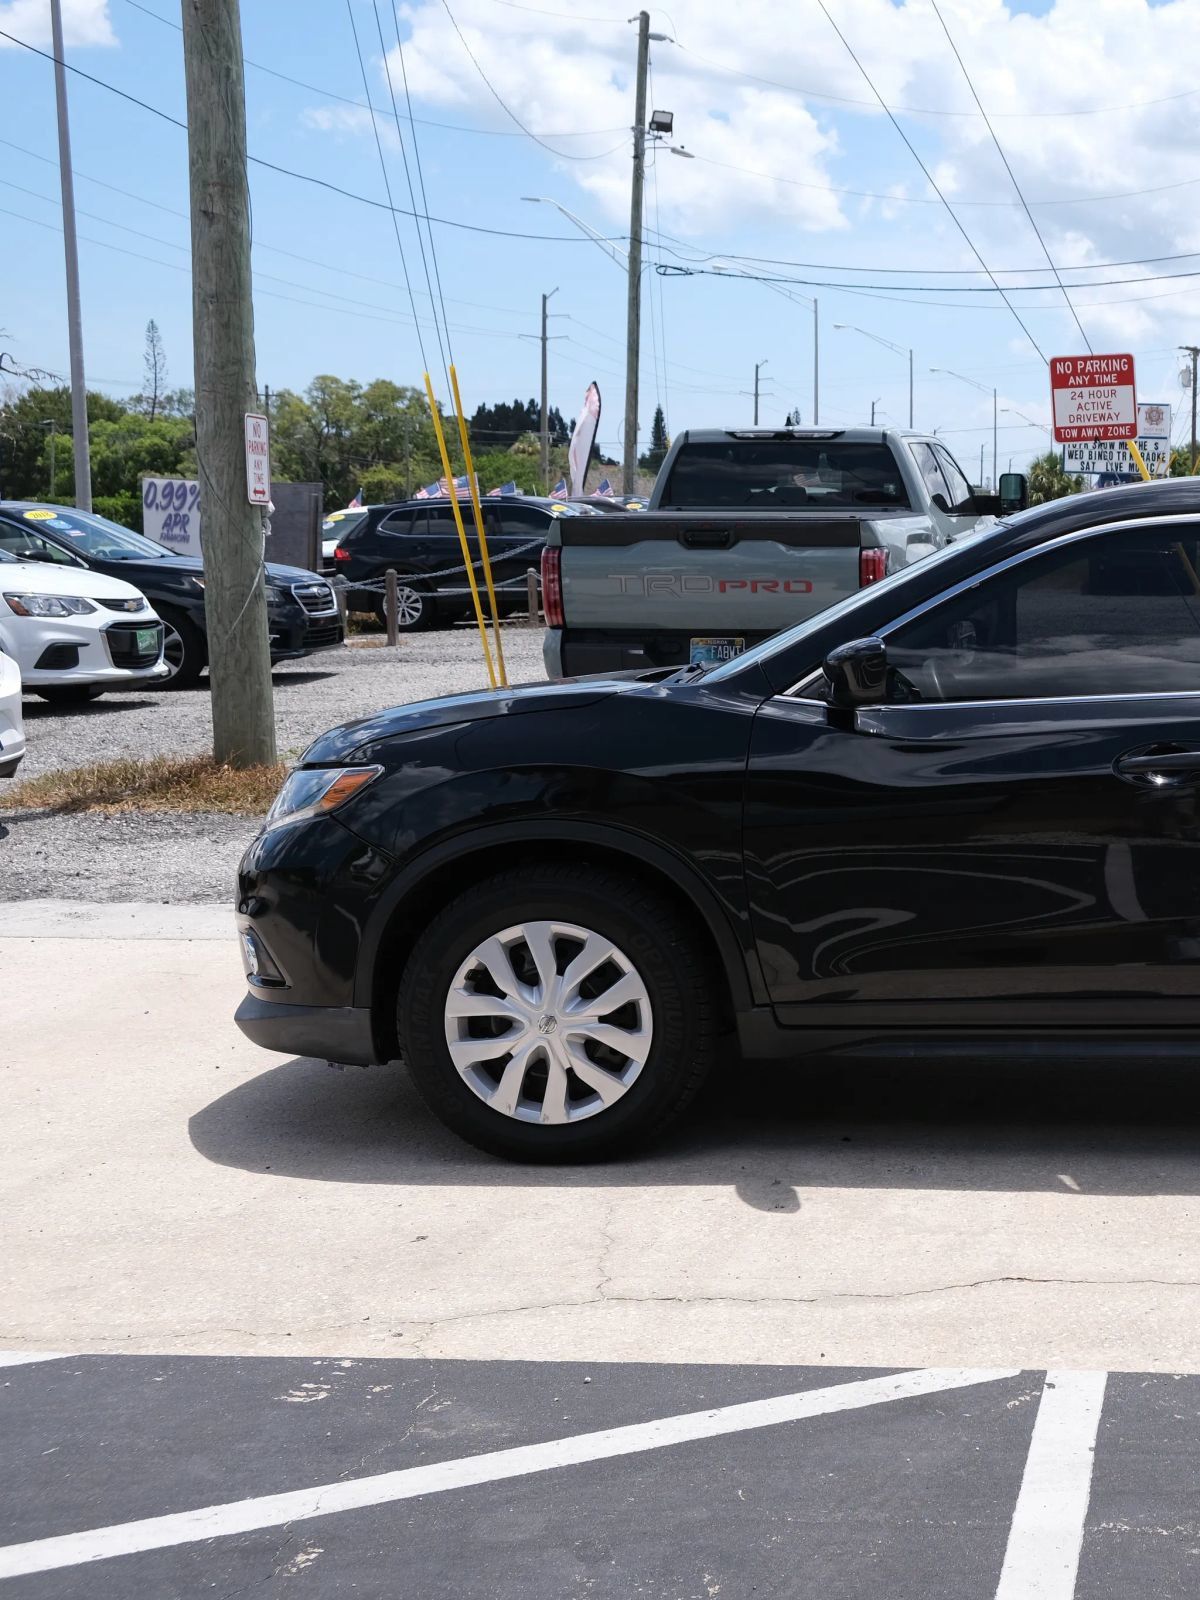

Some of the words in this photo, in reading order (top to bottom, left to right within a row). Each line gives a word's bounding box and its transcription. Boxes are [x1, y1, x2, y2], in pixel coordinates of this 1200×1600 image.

[1056, 361, 1072, 374] NO
[1077, 358, 1129, 373] PARKING
[1068, 375, 1090, 385] ANY
[1094, 373, 1118, 384] TIME
[1070, 390, 1084, 400] 24
[1088, 389, 1117, 399] HOUR
[1076, 401, 1112, 412] ACTIVE
[1068, 412, 1120, 423] DRIVEWAY
[252, 423, 262, 438] NO
[1060, 428, 1078, 439] TOW
[1081, 427, 1104, 438] AWAY
[1107, 425, 1131, 436] ZONE
[248, 440, 267, 456] PARKING
[1067, 450, 1084, 460] WED
[1088, 451, 1114, 461] BINGO
[1080, 461, 1096, 471] SAT
[1105, 462, 1123, 472] LIVE
[143, 481, 201, 512] 0.99%
[161, 513, 190, 534] APR
[607, 574, 714, 599] TRD
[718, 579, 814, 594] PRO
